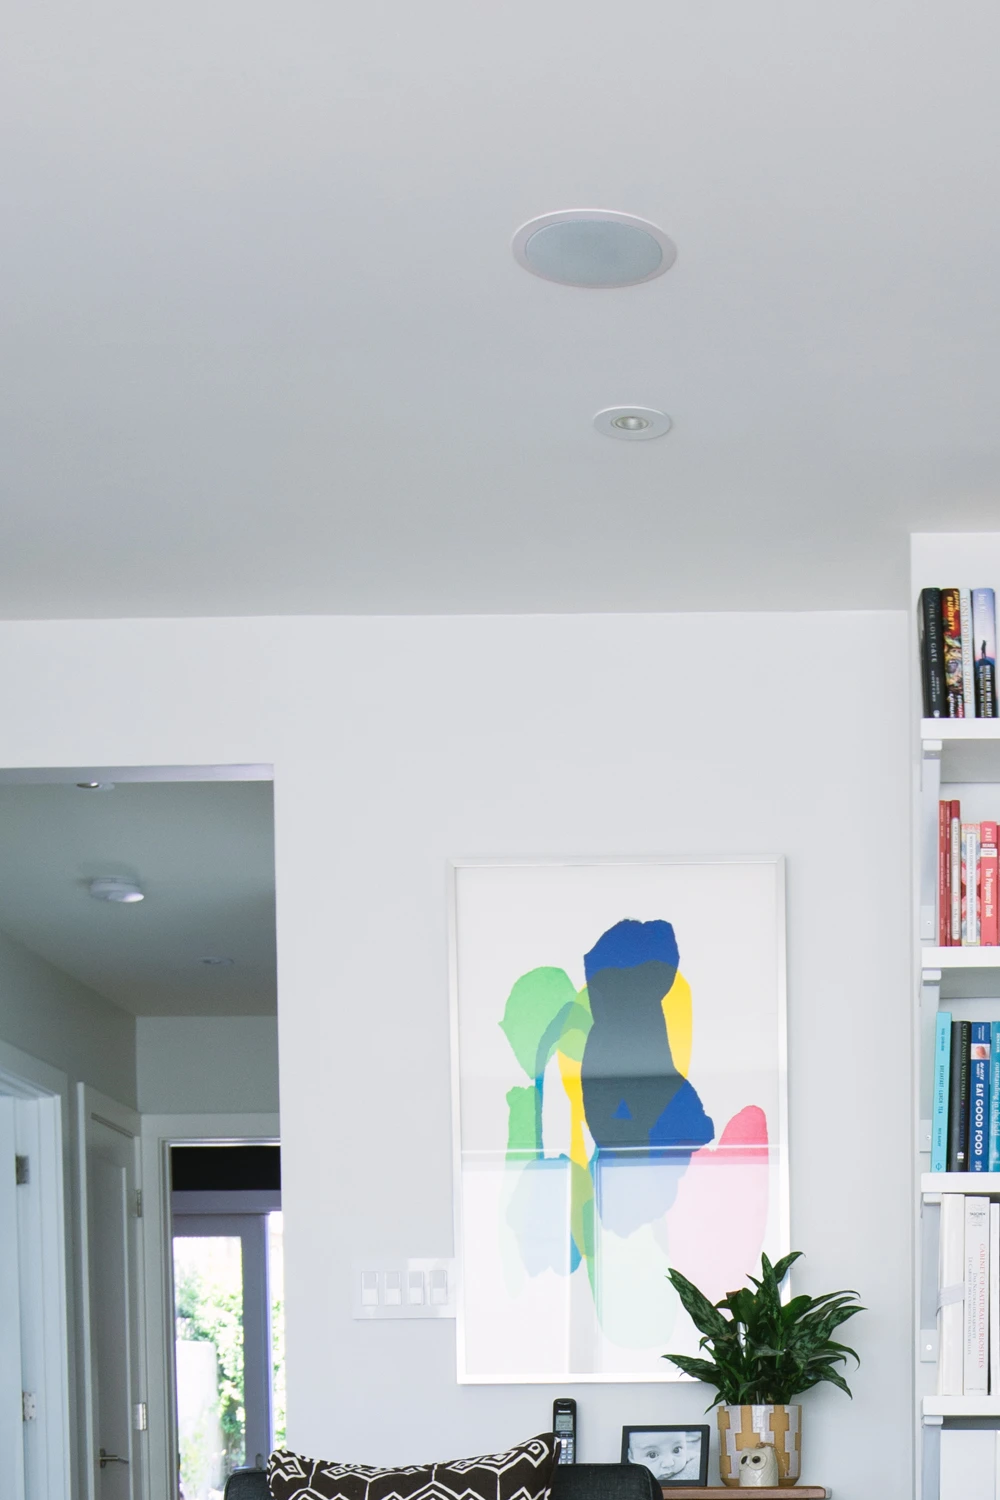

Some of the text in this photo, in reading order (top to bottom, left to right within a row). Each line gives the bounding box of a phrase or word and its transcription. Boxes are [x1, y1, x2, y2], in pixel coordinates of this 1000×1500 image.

[986, 868, 994, 878] The
[984, 878, 993, 904] Pregnancy
[976, 1083, 984, 1096] EAT
[975, 1099, 983, 1127] GOOD
